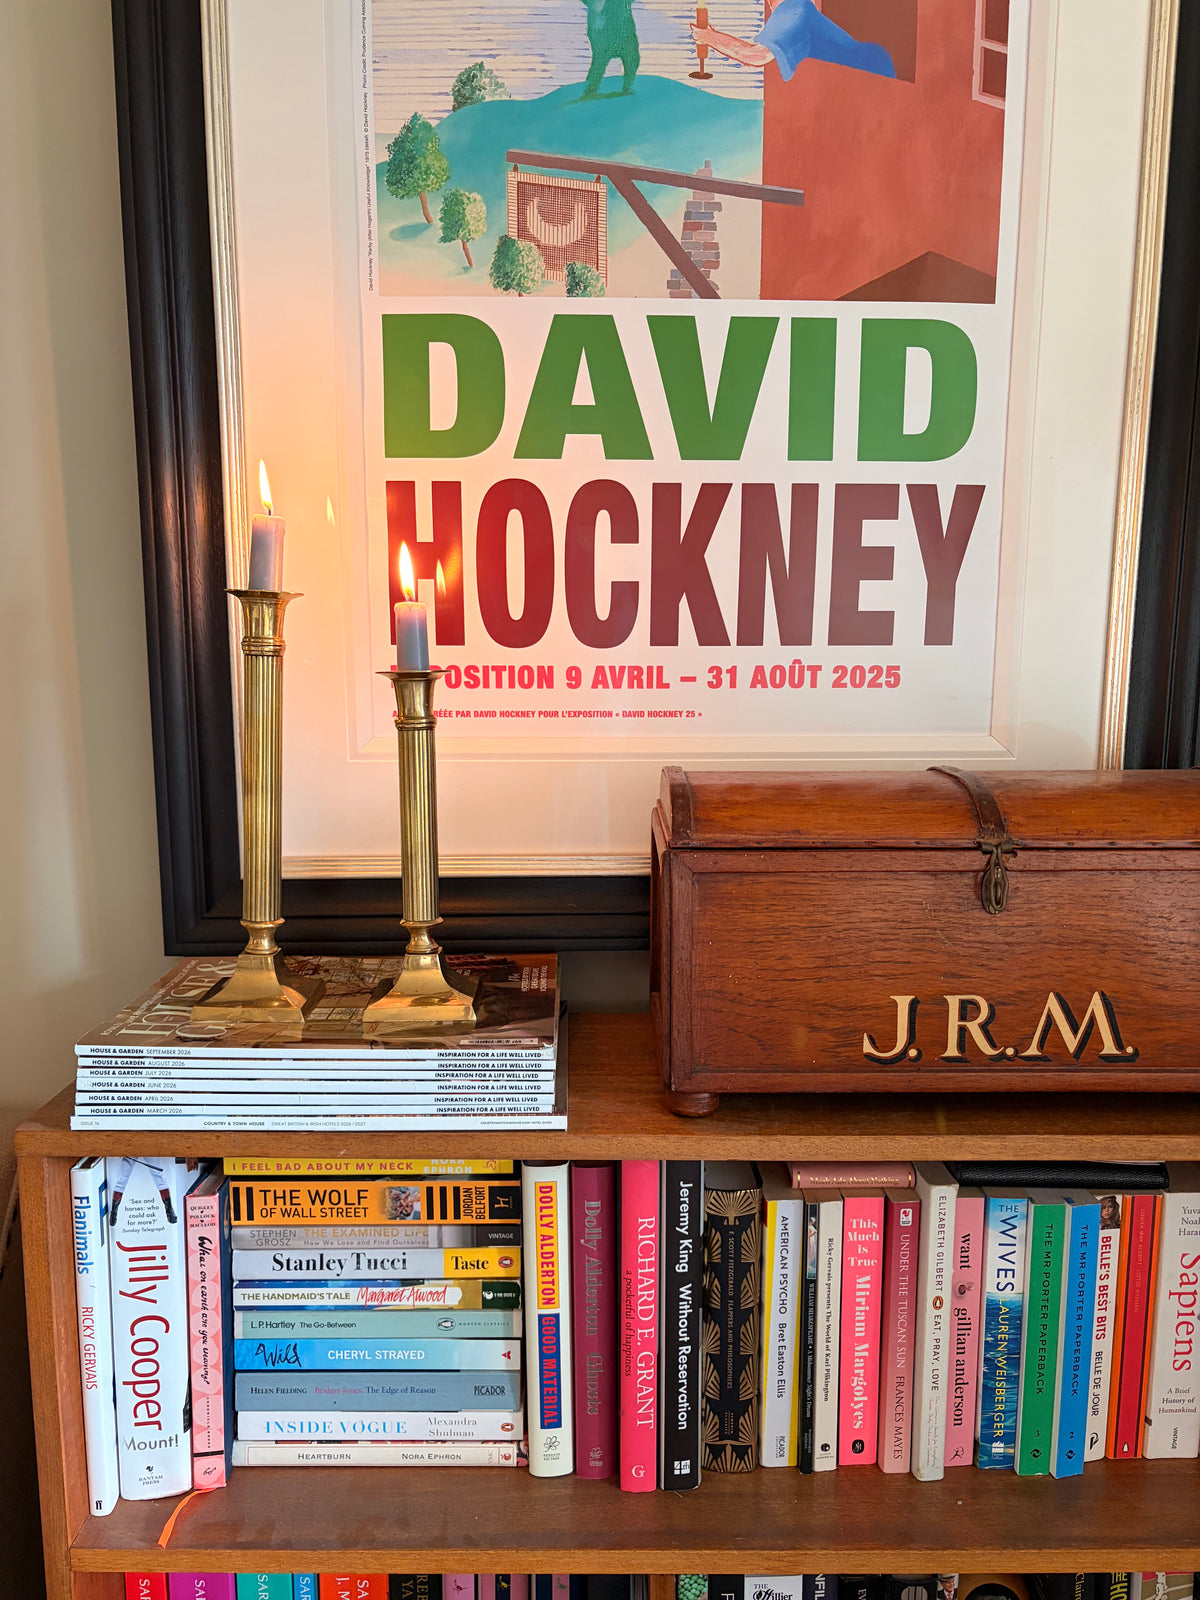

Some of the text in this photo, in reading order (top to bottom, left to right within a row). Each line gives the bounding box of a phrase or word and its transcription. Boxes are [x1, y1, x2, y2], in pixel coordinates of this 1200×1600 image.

[381, 313, 978, 462] DAVID
[385, 478, 986, 649] HOCKNEY
[390, 664, 554, 690] OSITION
[566, 665, 582, 690] 9
[591, 665, 670, 690] AVRIL
[707, 665, 737, 689] 31
[750, 658, 822, 689] AOÛT
[832, 665, 901, 689] 2025
[455, 710, 695, 718] PAR DAVID HOCKNEY POUR L'EXPOSITION DAVID HOCKNEY 25
[259, 1189, 369, 1206] THE WOLF
[260, 1207, 369, 1218] OF WALL STREET
[463, 1188, 473, 1218] JORDAN
[475, 1186, 485, 1219] BELFORT
[74, 1196, 94, 1274] Flanimals
[250, 1230, 296, 1238] STEPHEN
[304, 1229, 327, 1237] THE
[332, 1228, 399, 1237] EXAMINED
[675, 1181, 693, 1273] Jeremy King
[847, 1232, 880, 1241] Much
[850, 1219, 878, 1228] This
[539, 1185, 556, 1306] DOLLY ALDERTON
[848, 1257, 878, 1266] True
[858, 1245, 868, 1254] is
[900, 1235, 910, 1272] UNDER
[935, 1196, 946, 1292] ELIZABETH GILBERT
[960, 1233, 972, 1269] want
[996, 1214, 1018, 1292] WIVES
[1080, 1252, 1088, 1268] MR
[272, 1252, 407, 1276] Stanley Tucci
[451, 1256, 489, 1270] Taste
[580, 1200, 602, 1336] Dolly Alderton
[357, 1285, 448, 1308] Margaret Atwood
[899, 1275, 908, 1296] THE
[1077, 1274, 1085, 1321] PORTER
[636, 1216, 655, 1429] RICHARD E. GRANT
[776, 1216, 789, 1398] AMERICAN PSYCHO Bret Easton Ellis
[854, 1275, 870, 1337] Miriam
[897, 1300, 908, 1344] TUSCAN
[1036, 1224, 1053, 1395] THE MR PORTER PAPERBACK
[1169, 1253, 1200, 1371] Sapiens
[116, 1241, 170, 1431] Jilly Cooper
[933, 1314, 941, 1335] EAT,
[997, 1299, 1009, 1351] LAUREN
[1091, 1236, 1112, 1416] BELLE'S BEST BITS BELLE DE JOUR
[81, 1306, 97, 1390] RICKY GERVAIS
[255, 1343, 302, 1367] Wild
[328, 1350, 424, 1359] CHERYL STRAYED
[678, 1283, 692, 1430] Without Reservation
[896, 1346, 906, 1368] SUN
[932, 1338, 940, 1365] PRAY,
[1071, 1325, 1082, 1396] PAPERBACK
[542, 1316, 558, 1426] GOOD MATERIAL
[587, 1352, 603, 1415] Ghosts
[931, 1368, 940, 1391] LOVE
[954, 1307, 972, 1426] gillian anderson
[381, 1387, 399, 1395] Edge
[474, 1386, 505, 1395] PICADOR
[851, 1343, 869, 1429] Margolyes
[993, 1356, 1007, 1438] WEISBERGER
[266, 1421, 407, 1433] INSIDE VOGUE
[426, 1417, 477, 1425] Alexandra
[893, 1376, 905, 1459] FRANCES MAYES
[123, 1434, 179, 1451] Mount!
